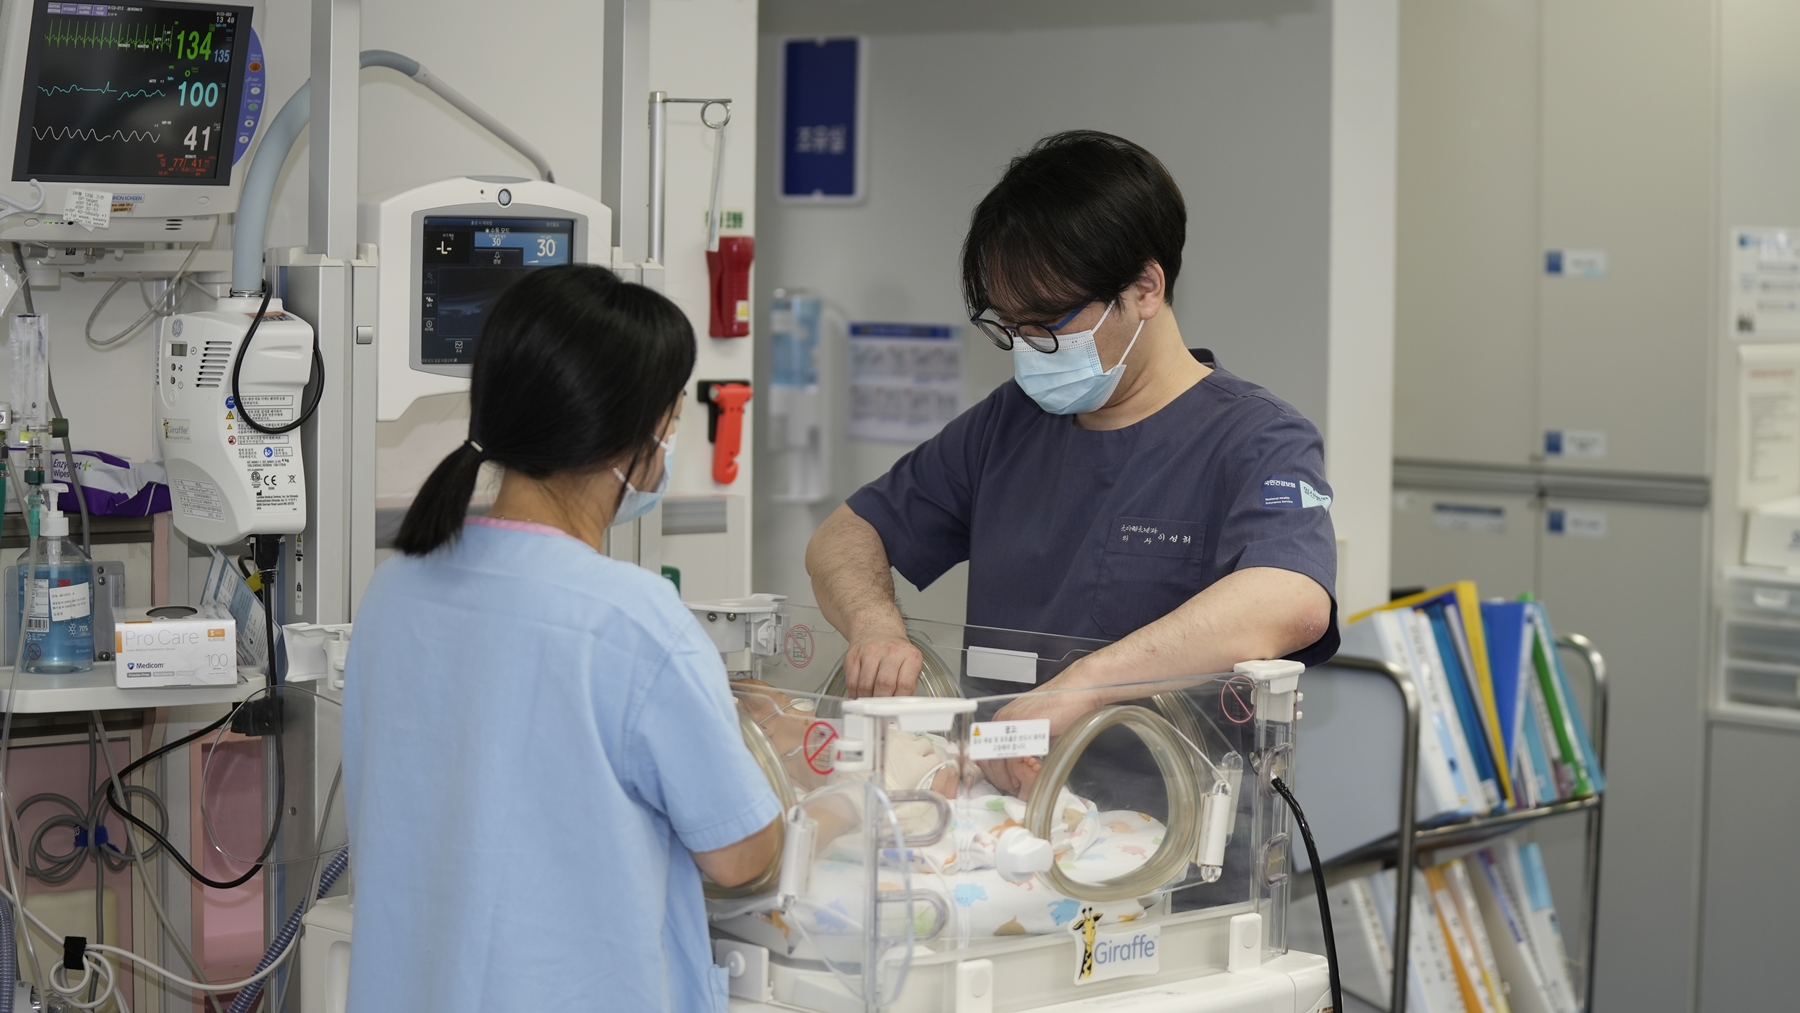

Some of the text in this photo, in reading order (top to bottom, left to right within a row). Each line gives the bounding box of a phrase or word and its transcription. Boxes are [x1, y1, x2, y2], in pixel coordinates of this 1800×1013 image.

[177, 30, 212, 60] 134
[214, 49, 230, 62] 135
[179, 81, 218, 107] 100
[184, 126, 210, 151] 41
[492, 238, 501, 246] 30
[537, 239, 556, 256] 30
[53, 470, 70, 479] Wipes
[126, 629, 198, 646] Pro Care
[206, 653, 228, 667] 100
[1094, 934, 1155, 964] Giraffe
